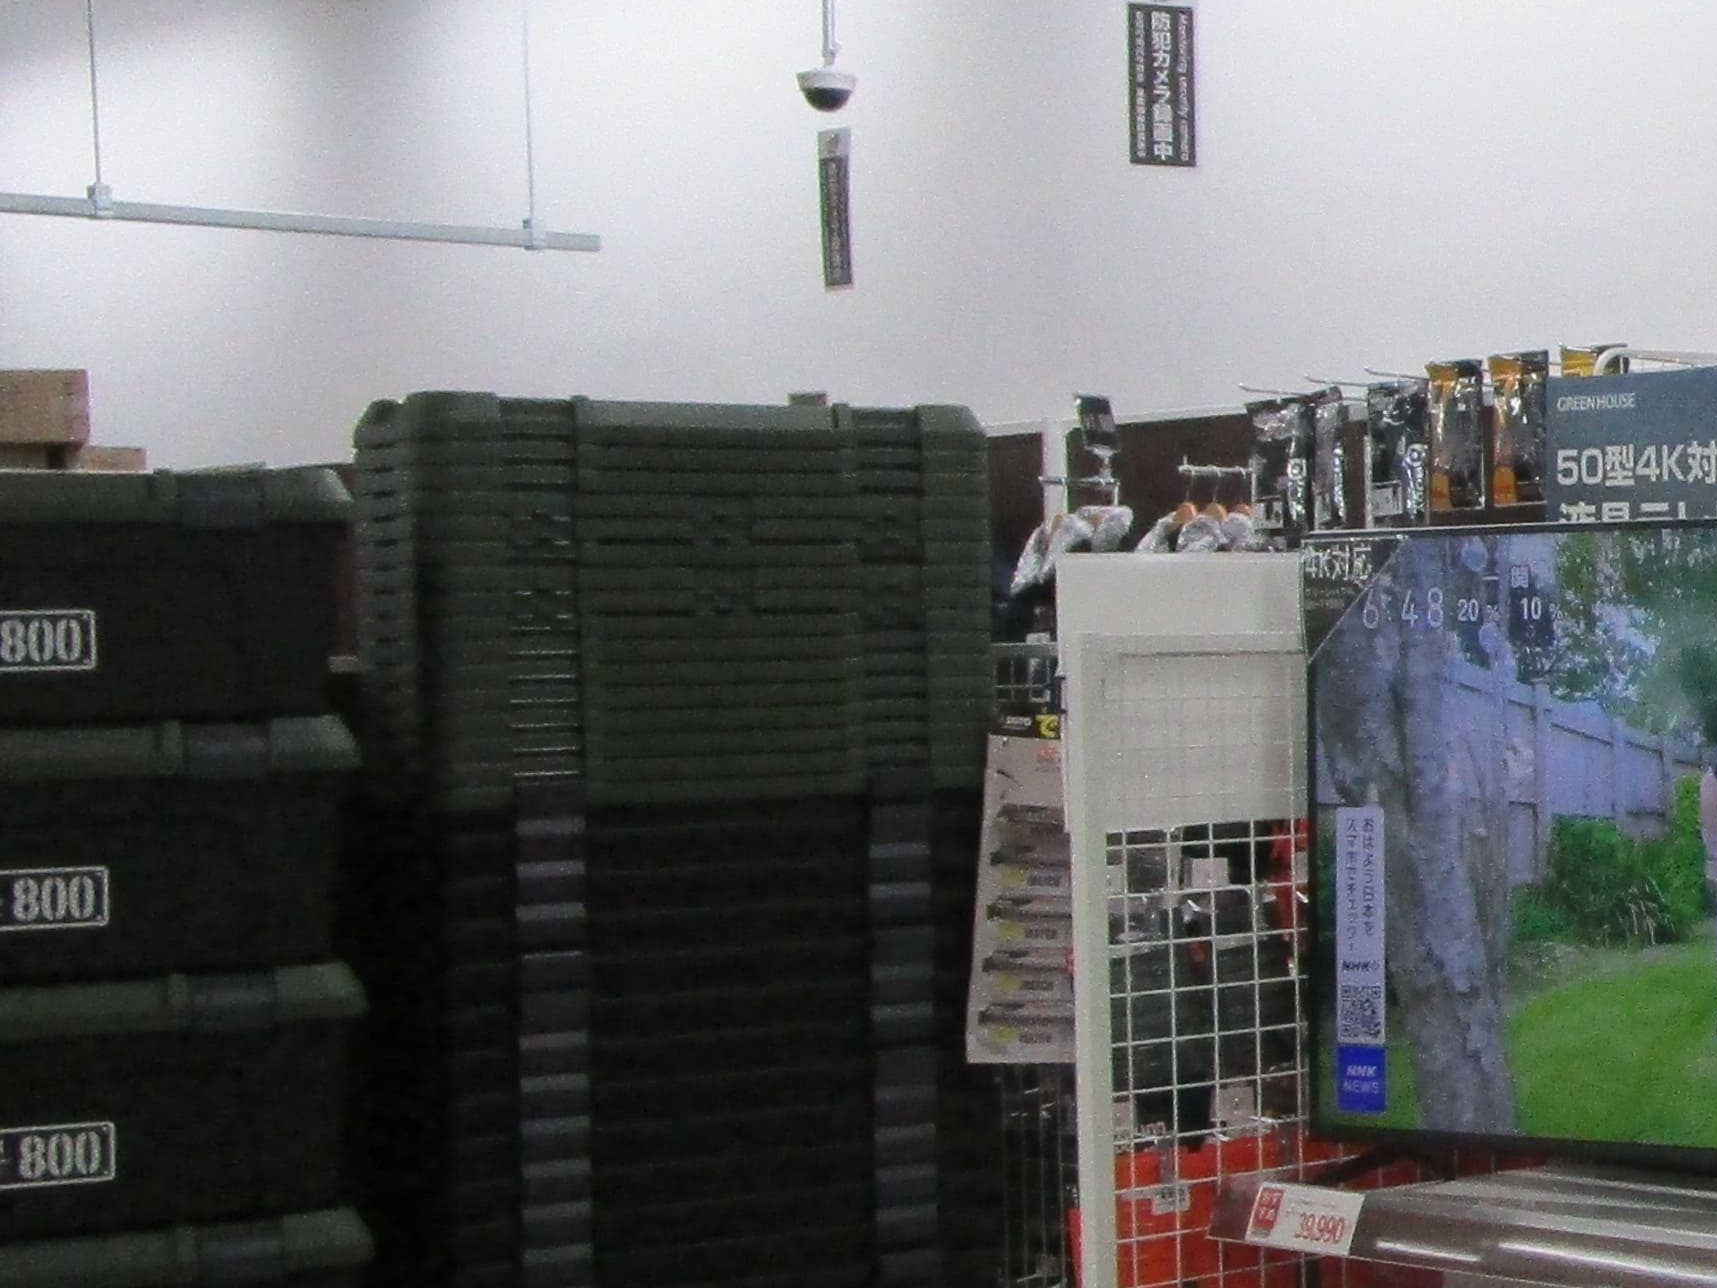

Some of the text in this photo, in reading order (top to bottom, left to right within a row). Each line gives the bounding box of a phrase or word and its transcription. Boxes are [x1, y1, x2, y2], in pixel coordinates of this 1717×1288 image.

[2, 615, 81, 664] 800
[13, 876, 94, 919] 800
[1343, 1079, 1381, 1096] NEWS
[18, 1131, 103, 1178] 800
